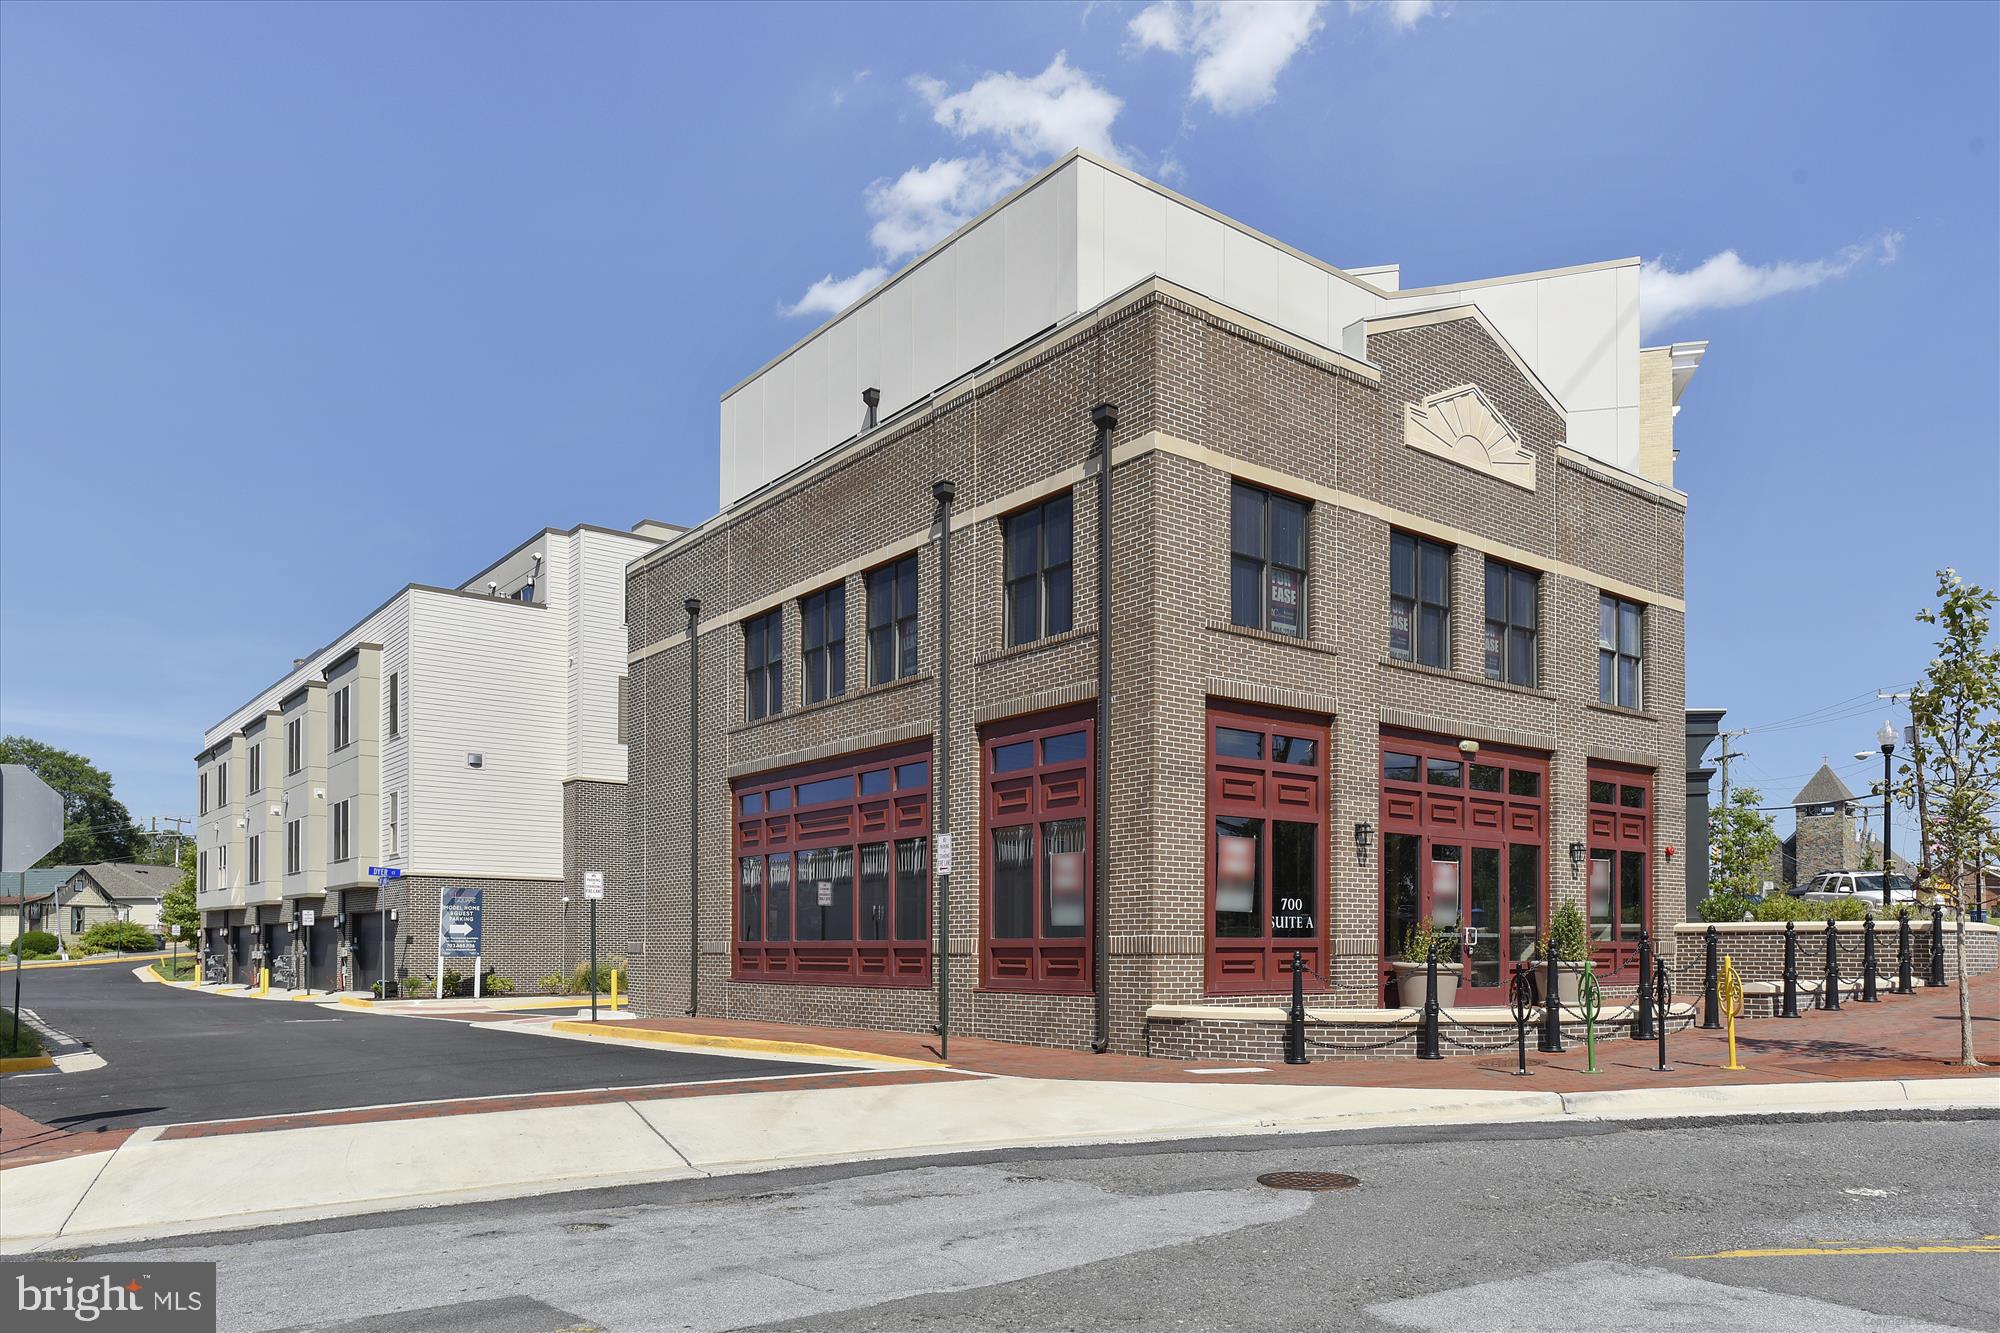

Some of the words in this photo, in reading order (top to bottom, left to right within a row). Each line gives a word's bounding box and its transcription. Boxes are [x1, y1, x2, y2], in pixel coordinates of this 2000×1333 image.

[1272, 586, 1296, 605] EASE
[374, 867, 388, 876] DYER
[1281, 898, 1303, 910] 700
[1272, 916, 1303, 928] SUITE
[1305, 916, 1314, 929] A
